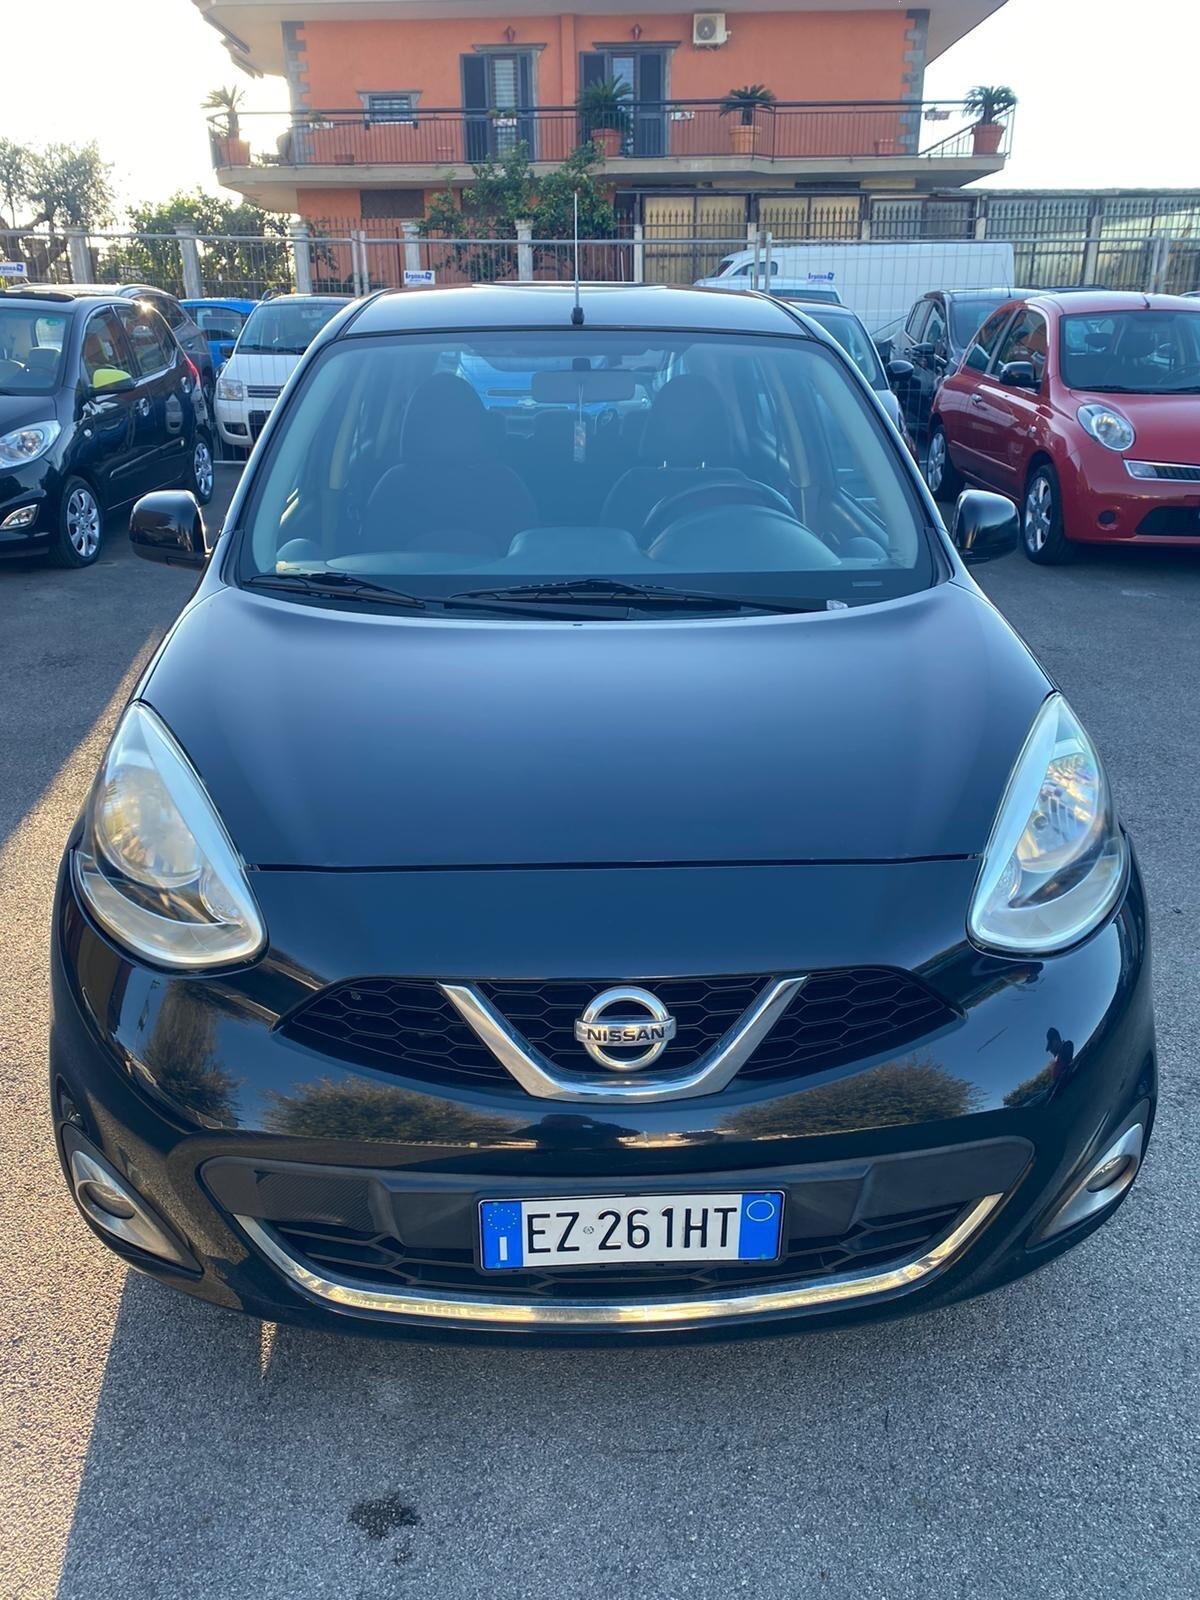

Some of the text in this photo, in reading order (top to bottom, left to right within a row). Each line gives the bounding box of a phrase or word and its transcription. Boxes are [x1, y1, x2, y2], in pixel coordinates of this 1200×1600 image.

[587, 1026, 665, 1042] NISSAN
[527, 1211, 580, 1254] EZ
[598, 1206, 738, 1251] 261HT
